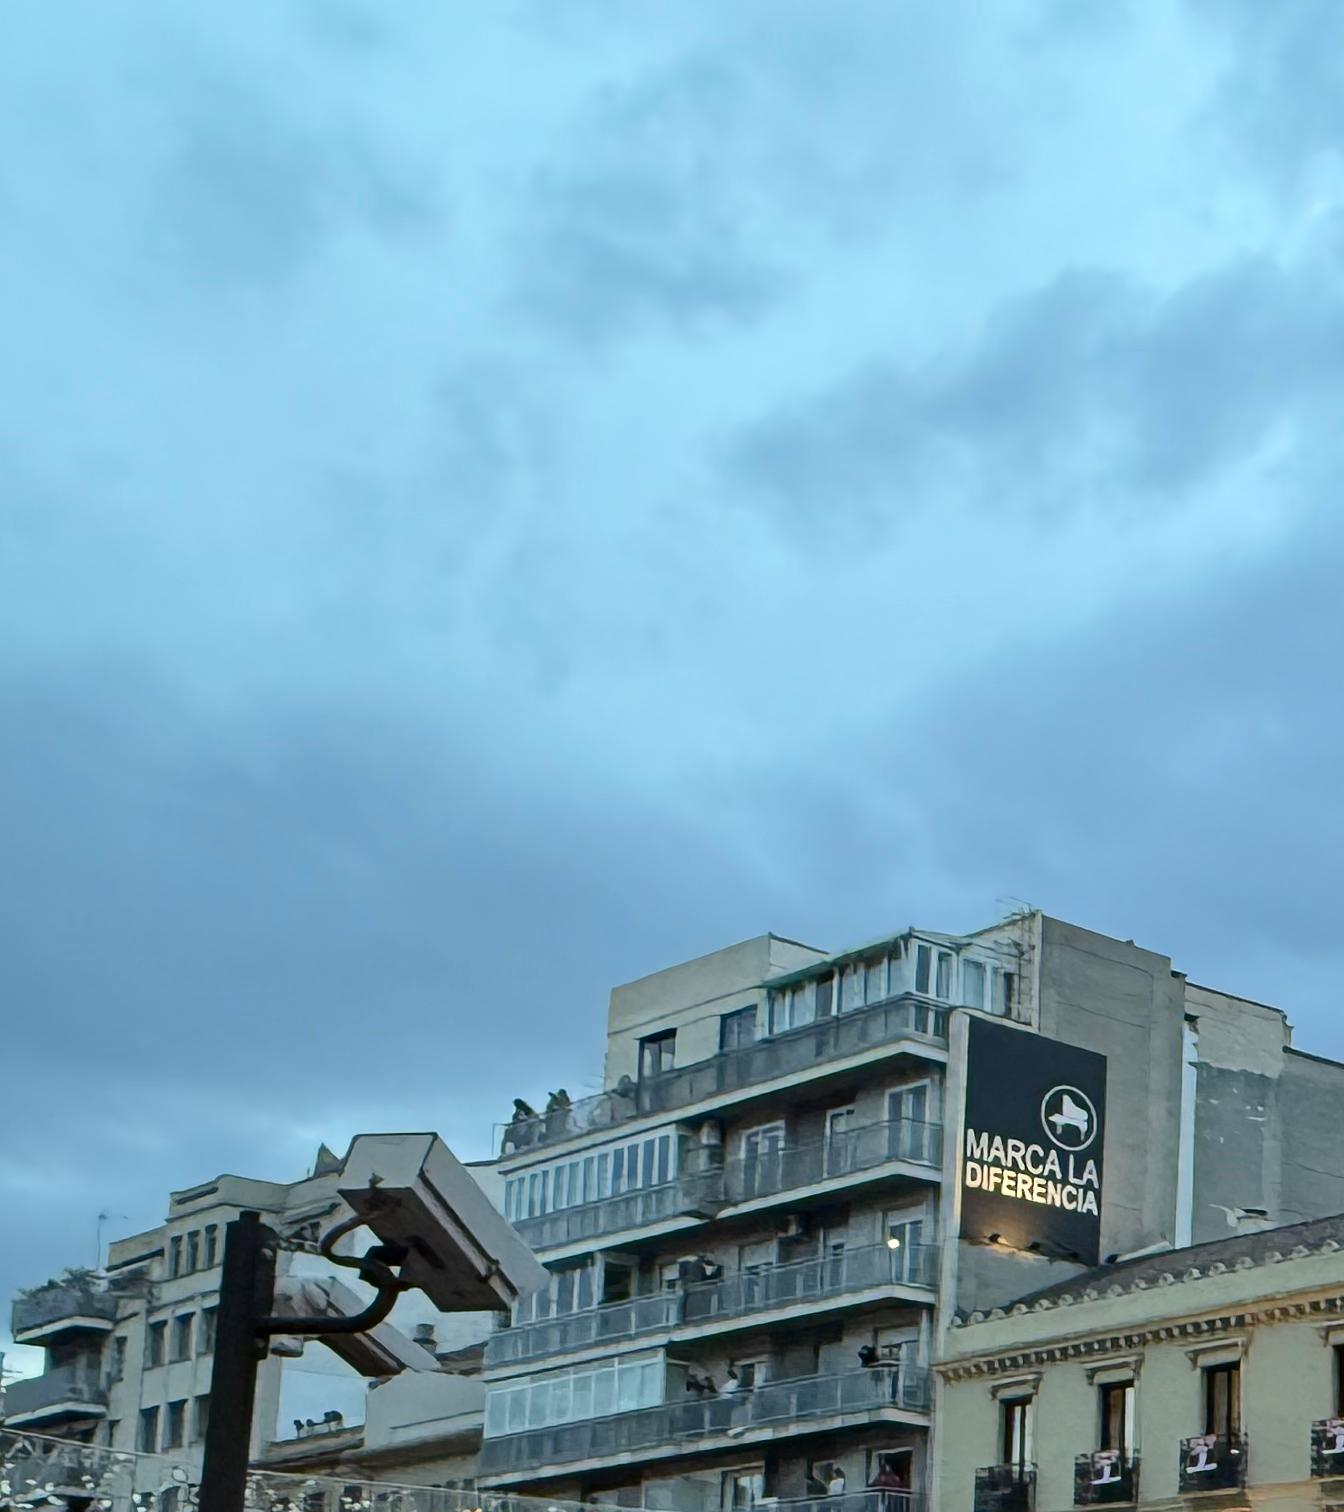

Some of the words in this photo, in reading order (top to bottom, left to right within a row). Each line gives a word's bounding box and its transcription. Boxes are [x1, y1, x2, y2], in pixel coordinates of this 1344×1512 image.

[966, 1128, 1062, 1179] MARCA
[1069, 1154, 1099, 1188] LA
[965, 1161, 1098, 1216] DIFERENCIA
